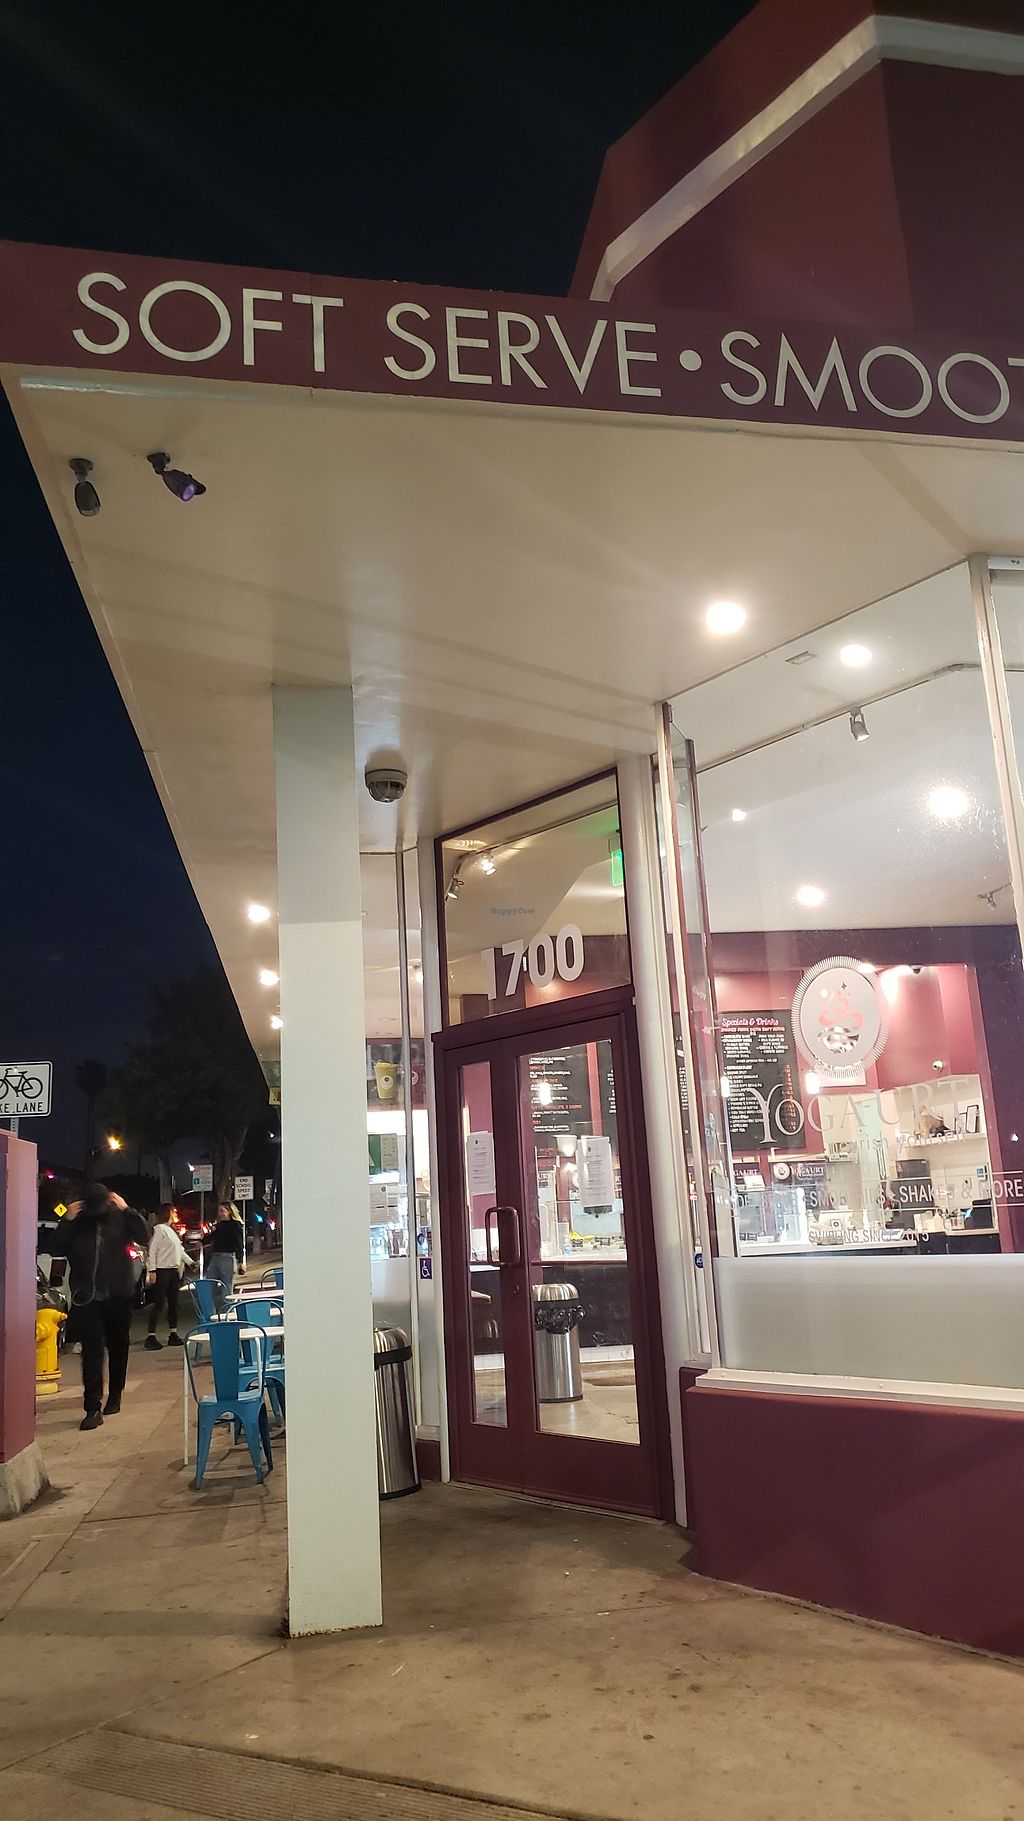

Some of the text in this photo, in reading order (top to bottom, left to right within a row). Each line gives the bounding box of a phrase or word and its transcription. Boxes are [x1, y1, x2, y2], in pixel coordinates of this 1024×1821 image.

[72, 272, 344, 372] SOFT
[383, 302, 662, 397] SERVE
[481, 924, 584, 1000] 1700
[16, 1102, 43, 1112] LANE
[741, 1078, 969, 1143] YOGAURT
